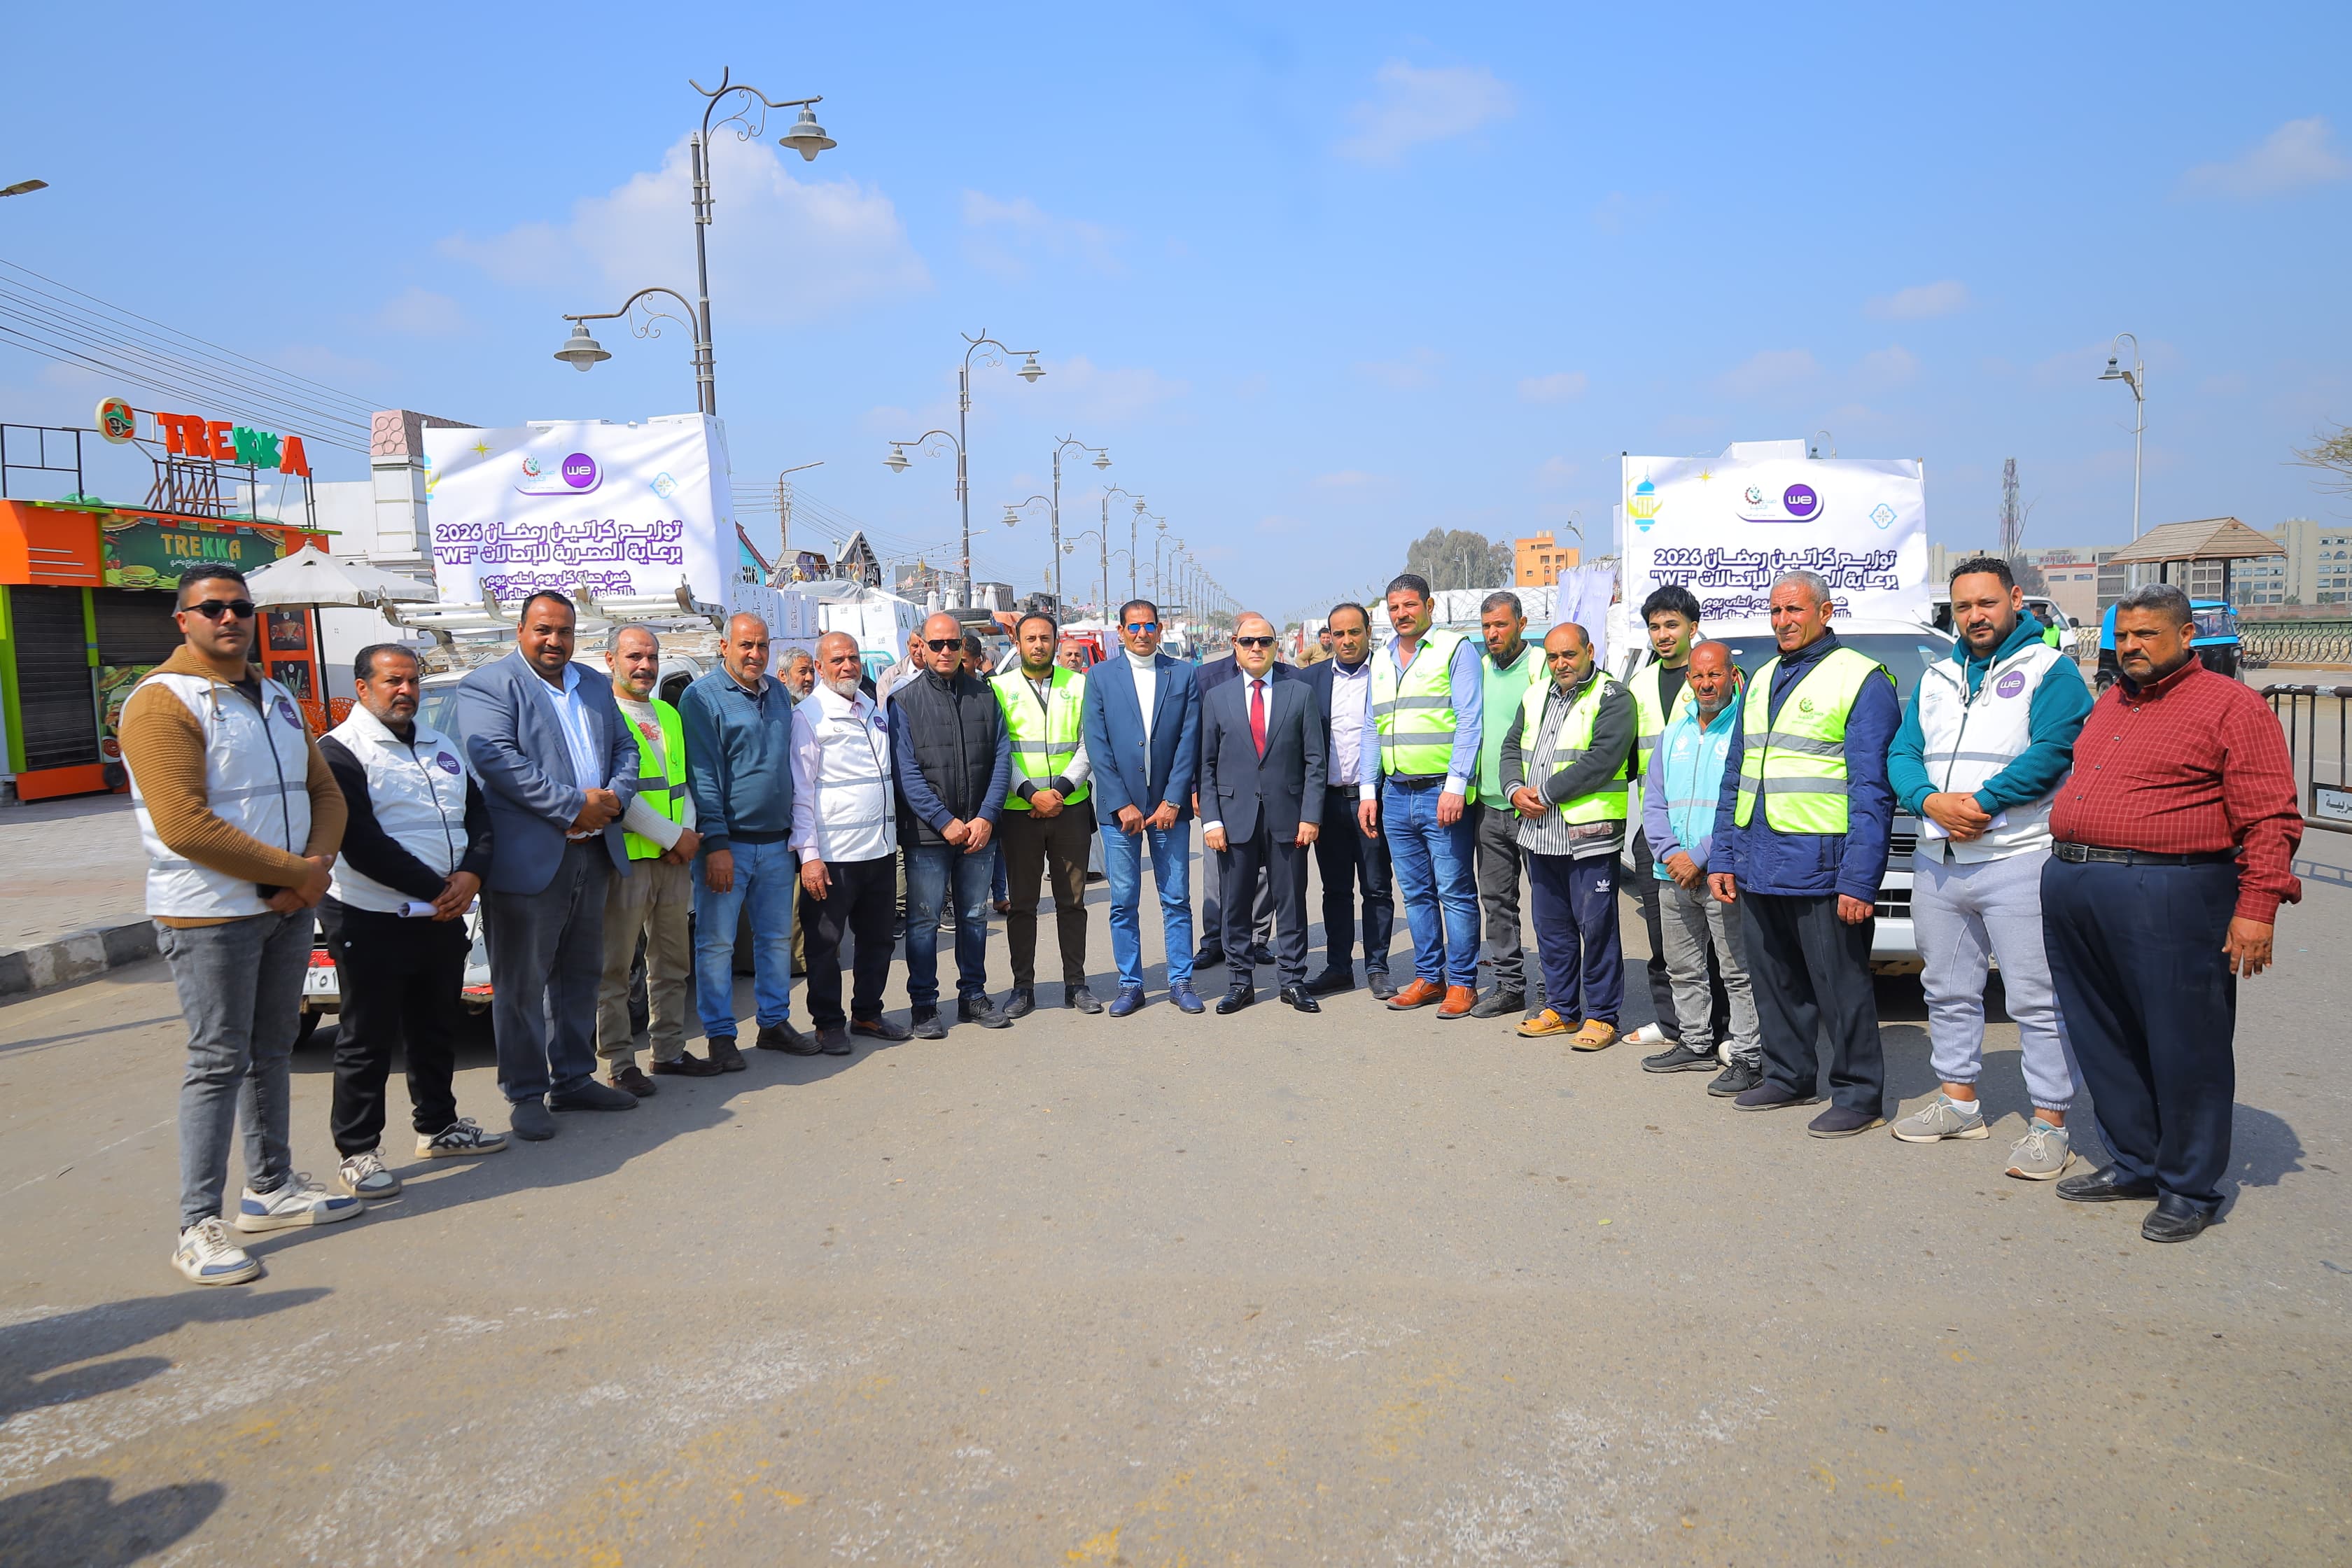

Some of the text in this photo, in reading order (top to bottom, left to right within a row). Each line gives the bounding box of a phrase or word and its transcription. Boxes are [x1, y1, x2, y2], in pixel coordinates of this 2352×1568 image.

[155, 412, 311, 477] TREKKA
[566, 465, 592, 475] we
[1788, 495, 1813, 505] we
[436, 519, 682, 544] توزيع كراتين رمضان 2026
[161, 533, 241, 560] TREKKA
[433, 542, 683, 566] برعاية المصرية للإتصالات "WE"
[1654, 547, 1898, 570] توزيع كراتين رمضان 2026
[485, 575, 507, 588] يوم
[535, 573, 557, 587] يوم
[558, 570, 575, 585] كل
[604, 570, 631, 585] ضمن
[1650, 569, 1900, 592] برعاية المة للإتصالات "WE"
[1702, 597, 1725, 610] يوم
[1829, 596, 1848, 607] ضم
[2000, 680, 2022, 689] we
